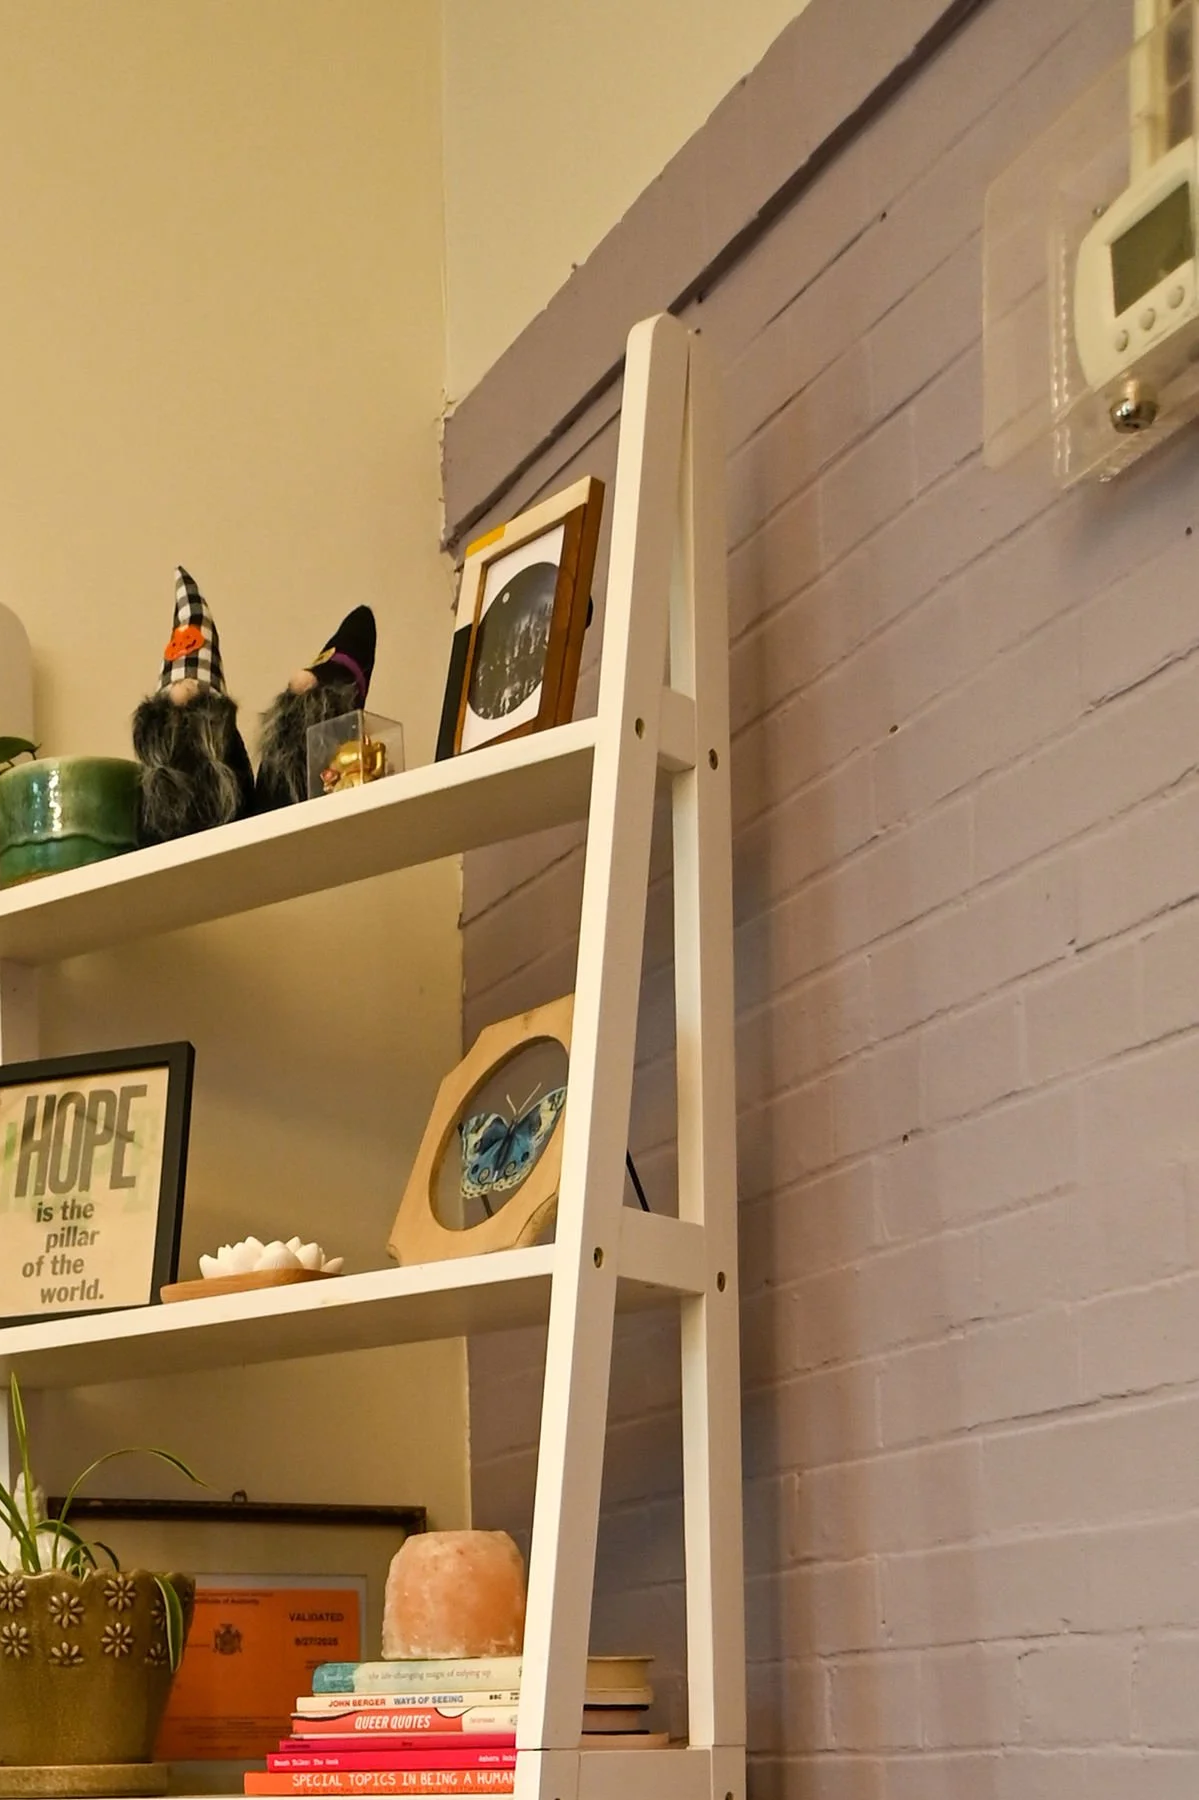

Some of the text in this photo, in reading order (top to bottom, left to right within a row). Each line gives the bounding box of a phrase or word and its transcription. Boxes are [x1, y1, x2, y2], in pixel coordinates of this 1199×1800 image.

[14, 1084, 148, 1198] HOPE
[36, 1199, 95, 1223] is the
[45, 1226, 100, 1253] pillar
[22, 1254, 85, 1278] of the
[40, 1279, 104, 1304] world.
[289, 1613, 344, 1622] VALIDATED
[329, 1698, 386, 1708] JOHN BERGER
[394, 1695, 464, 1705] WAYS OF SEEING
[355, 1715, 431, 1730] QUEER QUOTES
[292, 1772, 515, 1787] SPECIAL TOPICS IN BEING A HUMAN
